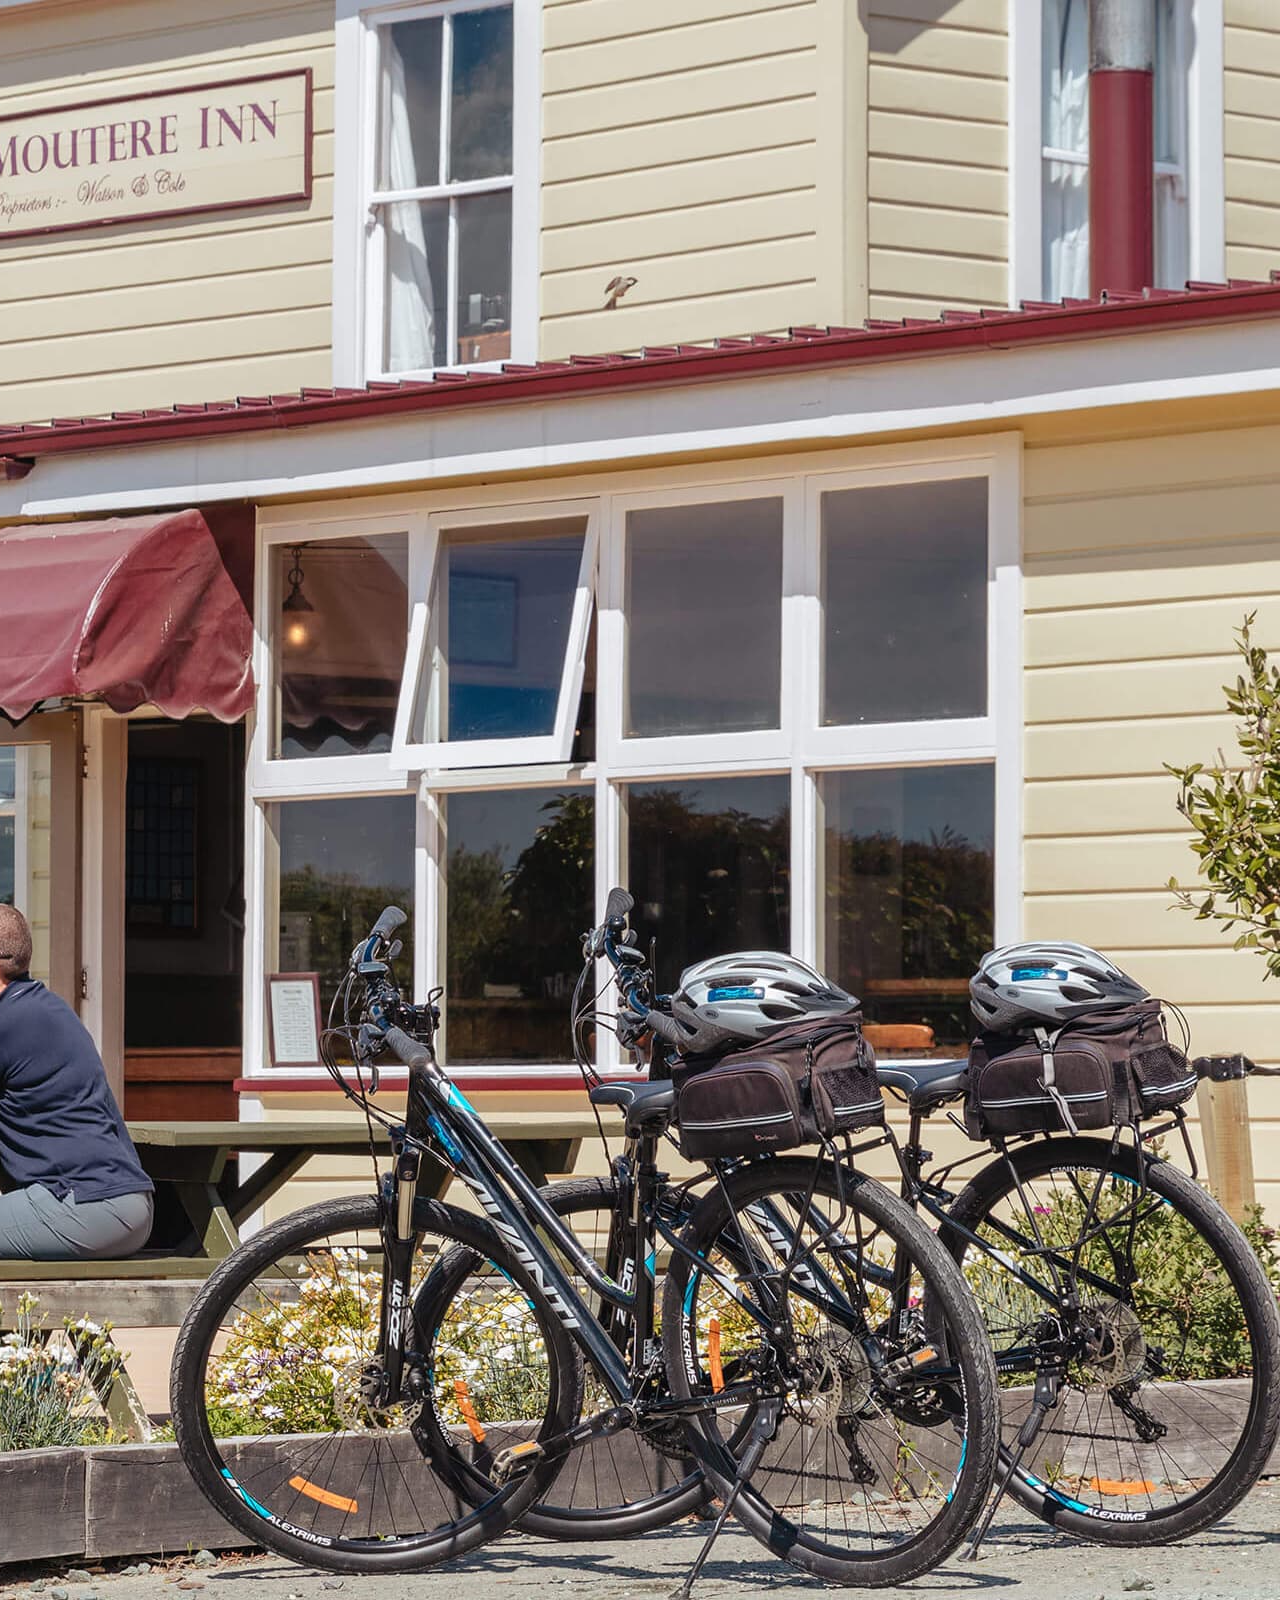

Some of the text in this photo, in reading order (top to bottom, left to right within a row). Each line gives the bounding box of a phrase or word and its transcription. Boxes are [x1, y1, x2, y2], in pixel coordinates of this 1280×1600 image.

[198, 98, 280, 151] INN
[76, 174, 125, 207] Watson
[154, 168, 187, 195] Cole
[458, 1171, 582, 1330] AVANTI
[682, 1310, 699, 1386] ALEXRIMS
[265, 1515, 333, 1547] ALEXRIMS
[1083, 1507, 1148, 1522] ALEXRIMS
